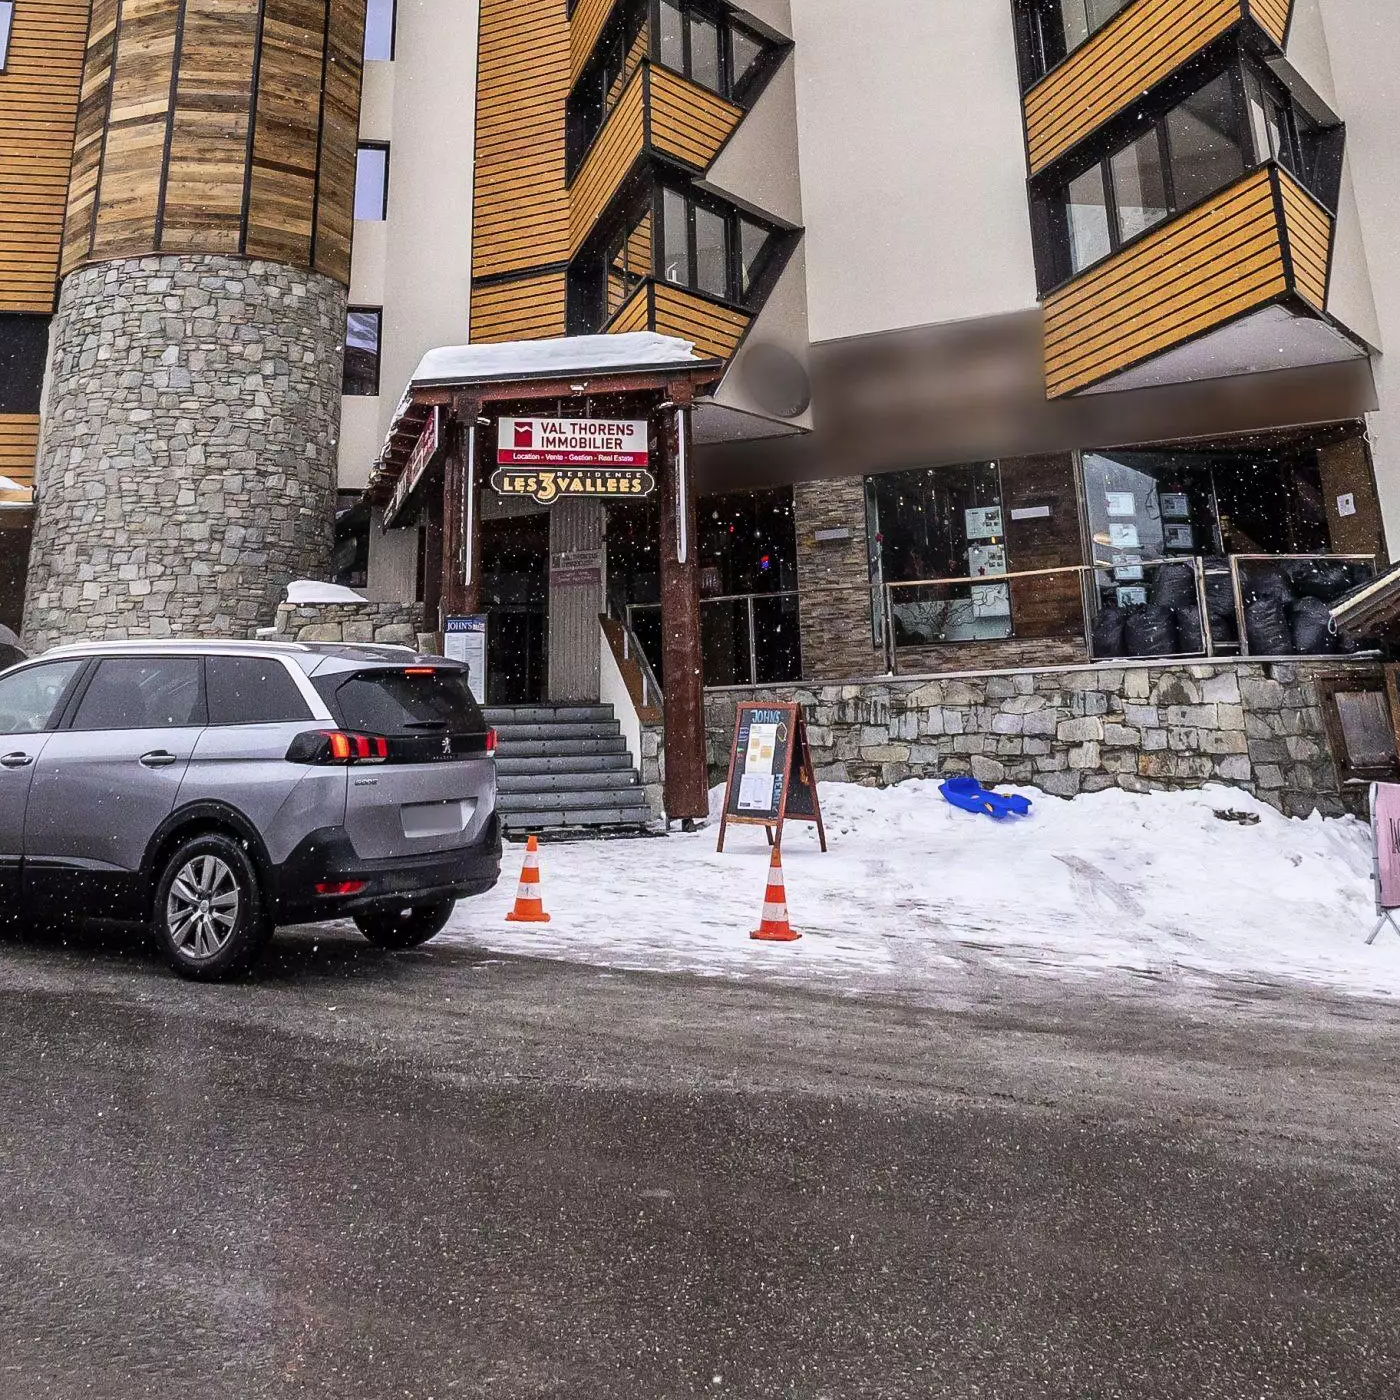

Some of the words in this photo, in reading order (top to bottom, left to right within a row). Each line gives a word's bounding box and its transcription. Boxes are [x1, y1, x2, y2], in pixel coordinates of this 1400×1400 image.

[541, 422, 566, 435] VAL
[570, 423, 634, 436] THORENS
[541, 436, 623, 450] IMMOBILIER
[598, 454, 613, 462] Real
[503, 477, 537, 492] LES
[537, 472, 556, 500] 3
[556, 478, 642, 493] VALLEES
[446, 621, 473, 632] JOHN'S
